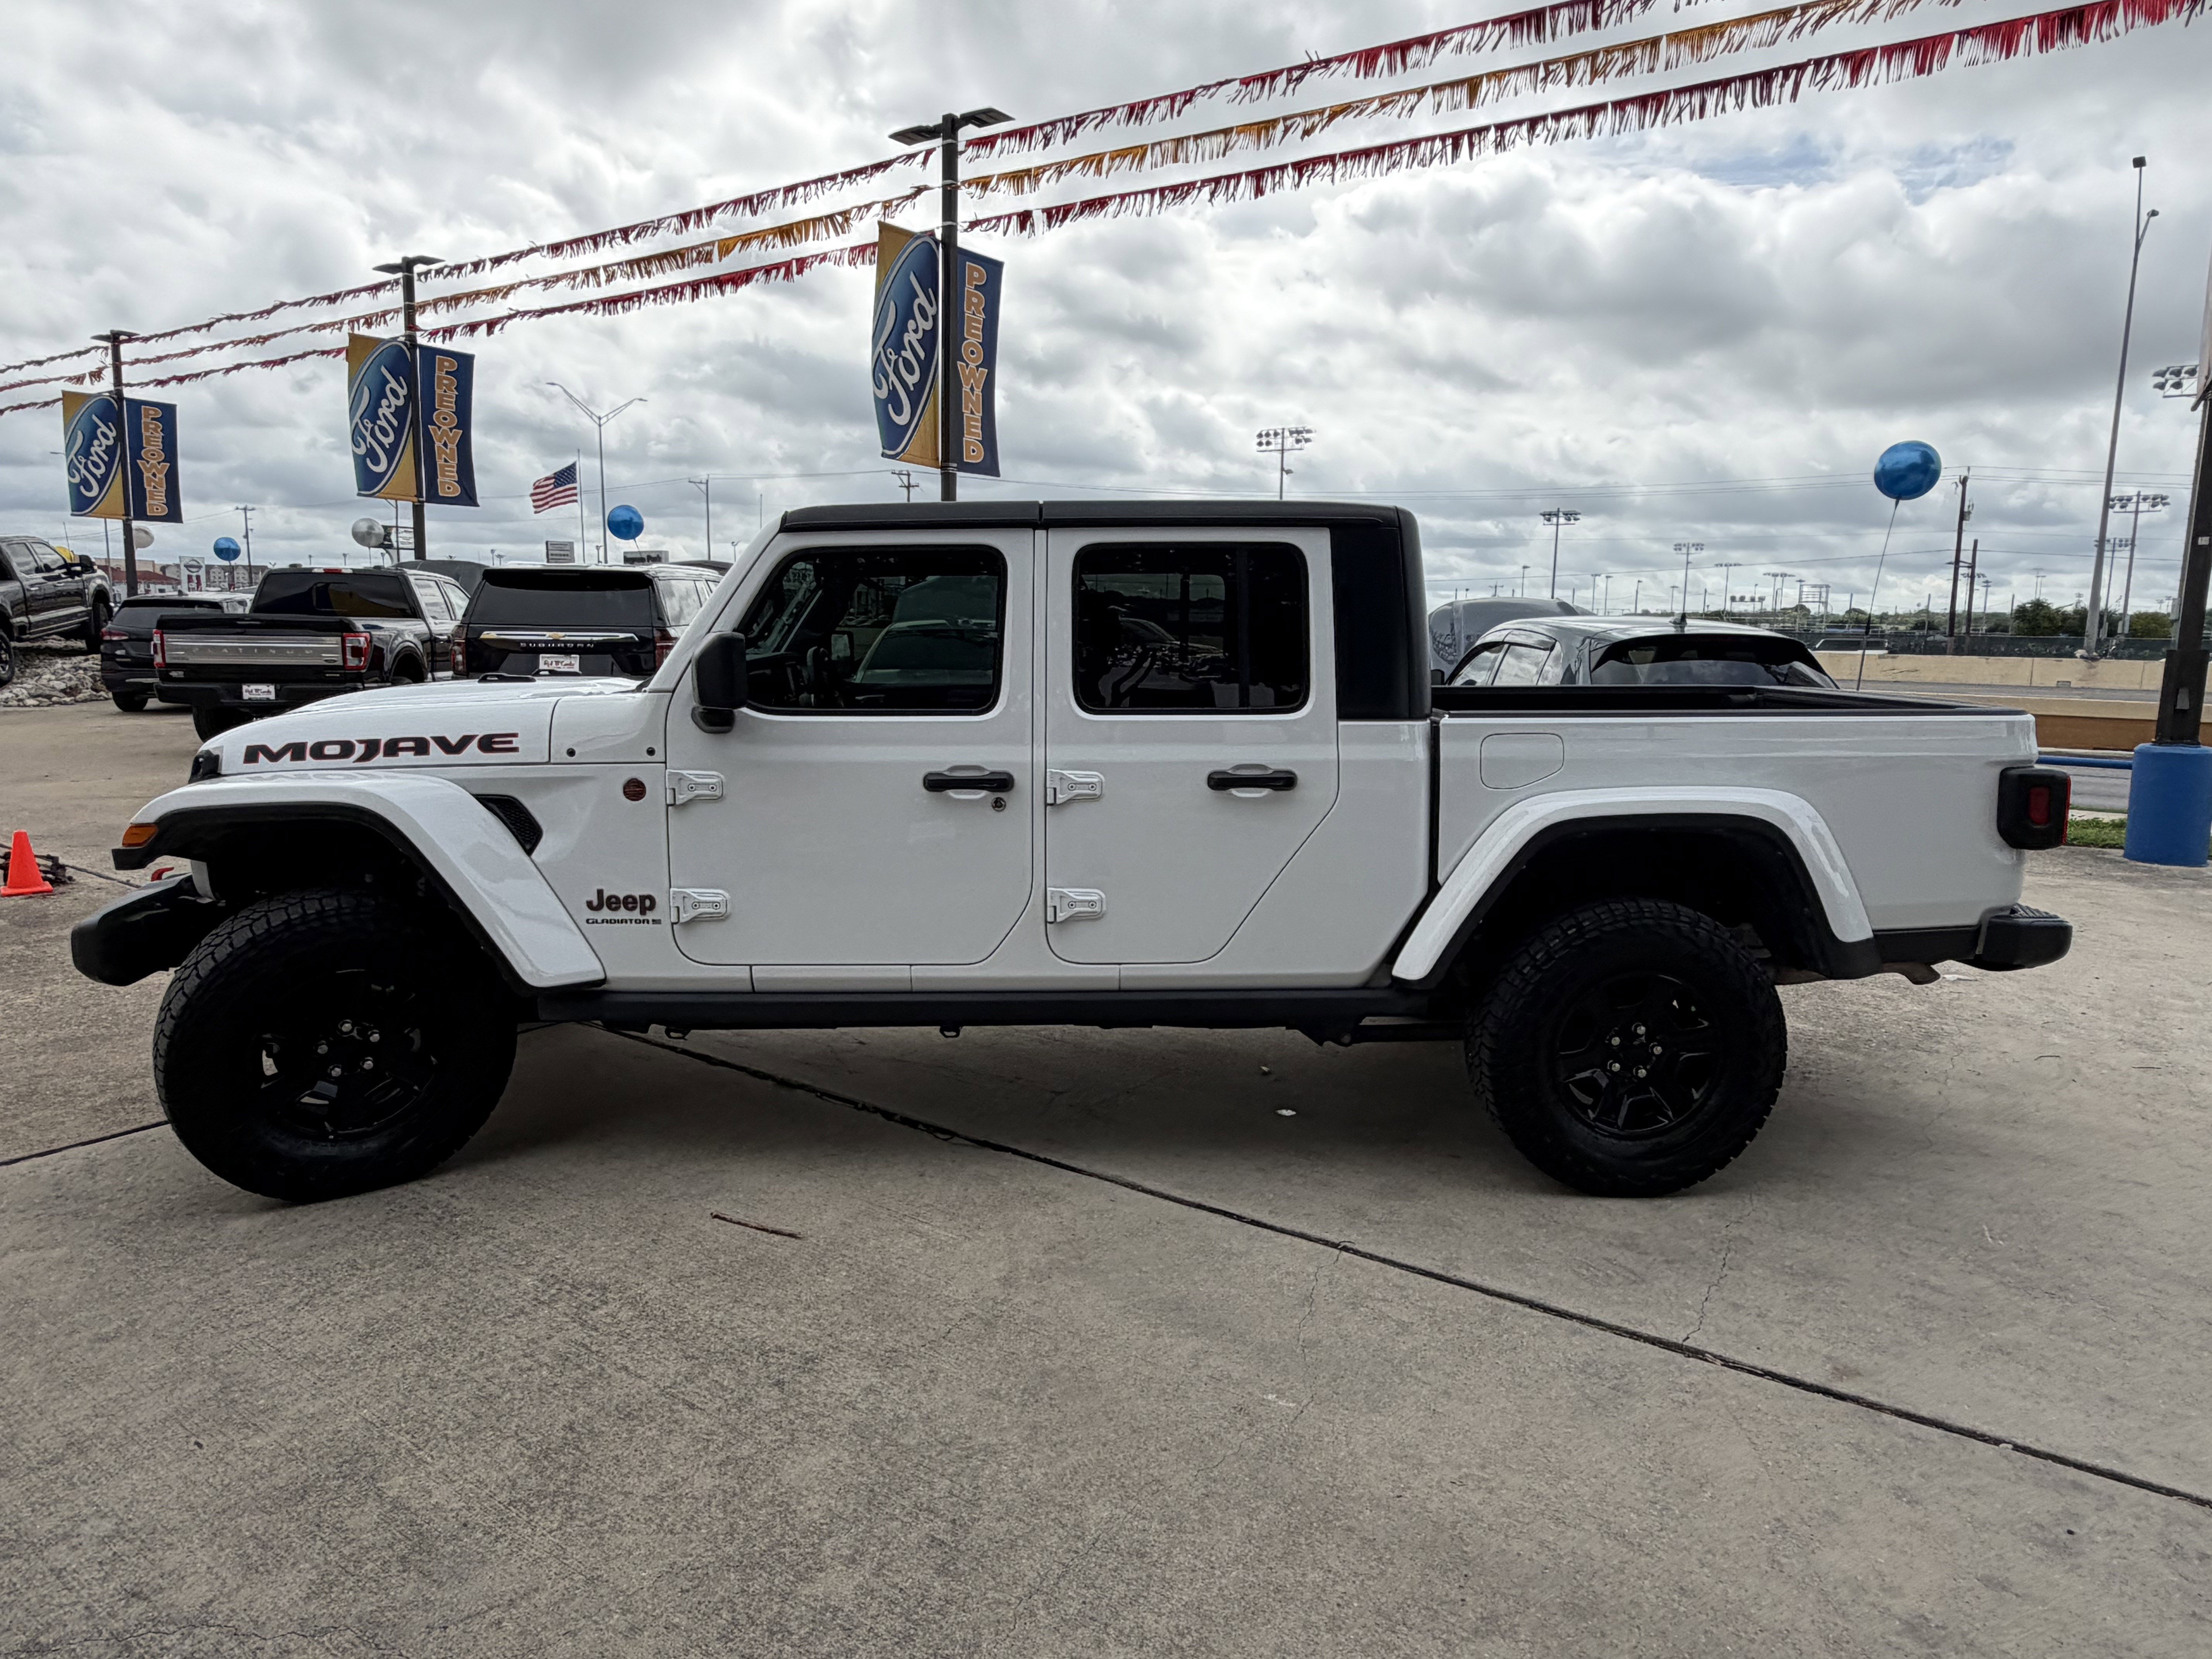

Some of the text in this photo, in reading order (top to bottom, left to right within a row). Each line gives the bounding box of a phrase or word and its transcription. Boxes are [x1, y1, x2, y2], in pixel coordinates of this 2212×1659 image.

[872, 271, 937, 426] Ford
[957, 262, 987, 463] PREOWNED
[67, 414, 117, 497] Ford
[136, 405, 170, 516] PREOWNED
[351, 366, 409, 473] Ford
[428, 356, 462, 497] PREOWNED
[243, 733, 519, 764] MOJAVE
[586, 889, 656, 915] Jeep
